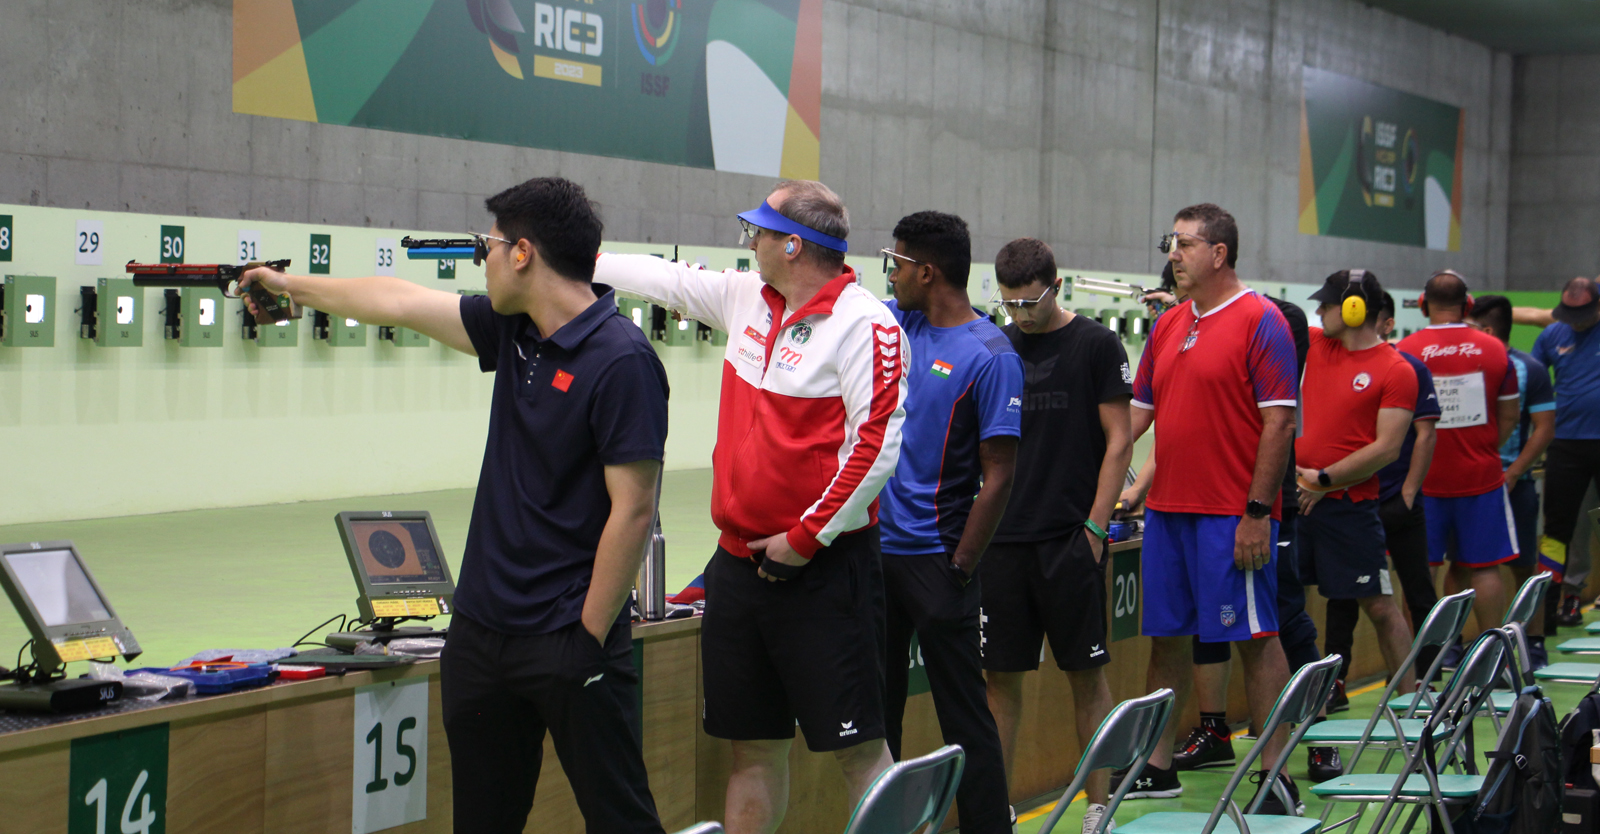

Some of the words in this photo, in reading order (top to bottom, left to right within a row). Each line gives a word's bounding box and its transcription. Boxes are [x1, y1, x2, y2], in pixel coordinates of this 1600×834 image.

[554, 62, 584, 79] 2023
[641, 72, 671, 97] ISSF
[79, 231, 100, 253] 29
[163, 236, 183, 258] 30
[240, 240, 258, 260] 31
[311, 245, 329, 265] 32
[377, 248, 393, 266] 33
[1459, 343, 1482, 358] Rico
[1440, 388, 1458, 397] PUR
[1114, 571, 1137, 618] 20
[100, 686, 115, 700] SIUS
[839, 727, 858, 737] erima
[365, 716, 417, 794] 15
[85, 769, 156, 834] 14
